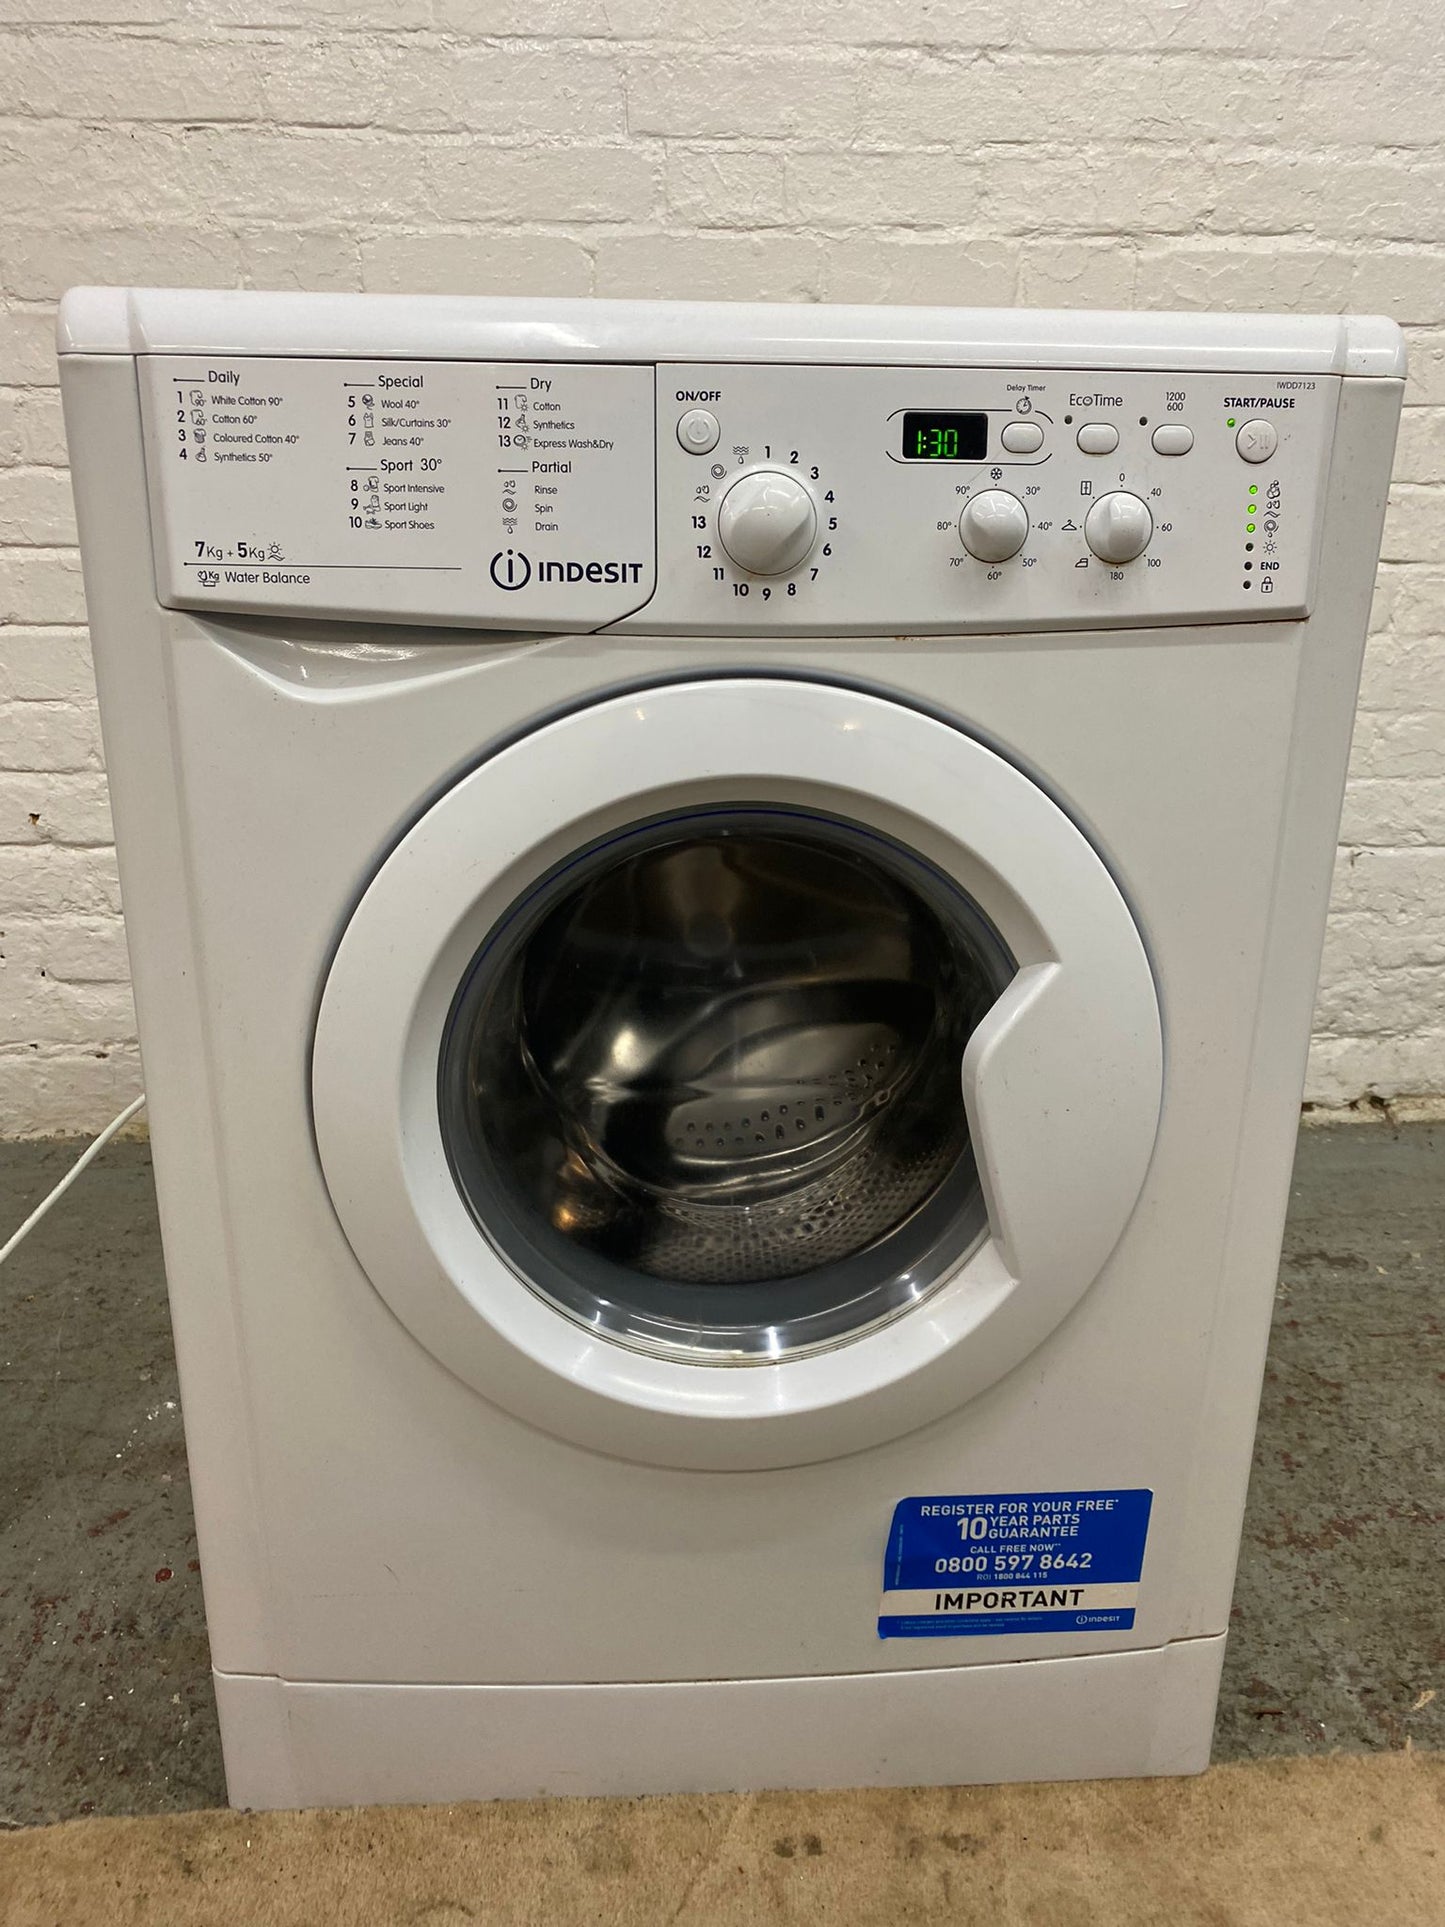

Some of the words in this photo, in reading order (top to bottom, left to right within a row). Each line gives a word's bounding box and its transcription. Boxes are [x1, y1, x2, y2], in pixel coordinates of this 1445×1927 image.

[208, 370, 240, 386] Daily
[378, 375, 424, 390] Special
[530, 378, 552, 392] Dry
[1007, 384, 1025, 392] Delay
[1277, 382, 1316, 390] IWDD7123
[177, 391, 182, 404] 1
[211, 395, 236, 405] White
[238, 396, 266, 406] Cotton
[348, 396, 356, 408] 5
[381, 399, 403, 408] Wool
[676, 391, 722, 402] ON/OFF
[1069, 393, 1123, 407] EcoTime
[1166, 392, 1186, 401] 1200
[497, 398, 509, 410] 11
[533, 402, 561, 411] Cotton
[1167, 402, 1183, 411] 600
[1224, 398, 1295, 409] START/PAUSE
[177, 410, 186, 422] 2
[212, 414, 241, 424] Cotton
[348, 414, 356, 426] 6
[382, 418, 435, 428] Silk/Curtains
[498, 416, 511, 429] 12
[533, 420, 575, 430] Synthetics
[178, 429, 186, 441] 3
[213, 434, 253, 443] Coloured
[255, 434, 283, 444] Cotton
[348, 433, 356, 445] 7
[382, 437, 408, 446] Jeans
[498, 435, 511, 447] 13
[534, 439, 566, 450] Express
[569, 440, 614, 450] Wash&Dry
[917, 429, 958, 457] 1:30
[179, 448, 188, 460] 4
[214, 452, 256, 463] Synthetics
[765, 446, 771, 458] 1
[790, 451, 799, 464] 2
[380, 459, 413, 473] Sport
[420, 458, 442, 471] 30°
[532, 461, 572, 474] Partial
[810, 466, 819, 479] 3
[350, 480, 358, 491] 8
[384, 484, 406, 494] Sport
[407, 484, 445, 493] Intensive
[534, 486, 558, 495] Rinse
[1150, 488, 1161, 496] 40
[824, 490, 835, 503] 4
[351, 498, 359, 510] 9
[384, 502, 406, 512] Sport
[408, 502, 428, 513] Light
[535, 504, 553, 514] Spin
[349, 516, 362, 528] 10
[384, 520, 407, 530] Sport
[408, 521, 435, 529] Shoes
[535, 522, 558, 531] Drain
[691, 516, 706, 528] 13
[828, 518, 837, 530] 5
[1161, 523, 1172, 532] 60
[697, 546, 711, 558] 12
[823, 543, 832, 556] 6
[1147, 559, 1161, 567] 100
[1260, 561, 1279, 570] END
[225, 571, 259, 583] Water
[263, 572, 310, 583] Balance
[713, 568, 724, 580] 11
[810, 568, 819, 581] 7
[1110, 571, 1124, 580] 180
[733, 584, 749, 596] 10
[762, 588, 771, 601] 9
[787, 583, 796, 595] 8
[921, 1503, 994, 1516] REGISTER
[999, 1502, 1027, 1514] FOR
[1032, 1501, 1071, 1512] YOUR
[990, 1515, 1028, 1527] YEAR
[1032, 1514, 1080, 1526] PARTS
[956, 1516, 988, 1540] 10
[988, 1526, 1078, 1539] GUARANTEE
[970, 1545, 997, 1554] CALL
[1000, 1544, 1027, 1553] FREE
[935, 1556, 988, 1573] 0800
[994, 1555, 1034, 1571] 597
[1039, 1552, 1092, 1569] 8642
[1033, 1571, 1047, 1579] 115
[935, 1589, 1084, 1610] IMPORTANT
